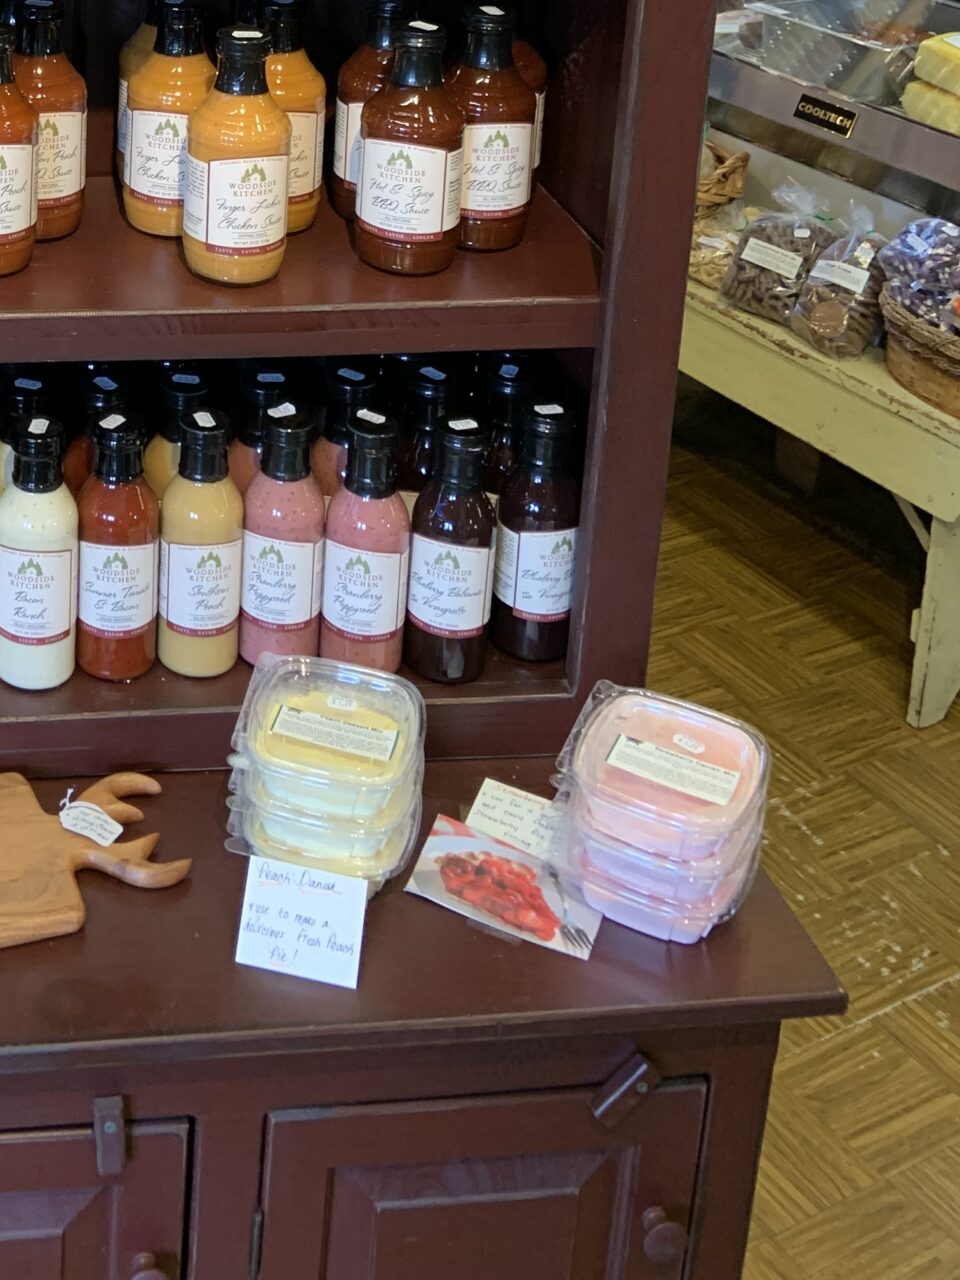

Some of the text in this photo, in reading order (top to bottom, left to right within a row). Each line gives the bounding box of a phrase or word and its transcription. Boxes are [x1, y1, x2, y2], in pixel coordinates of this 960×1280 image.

[798, 102, 851, 128] COOLTECH
[377, 164, 426, 176] WOODSIDE
[229, 180, 277, 190] WOODSIDE
[380, 174, 421, 183] KITCHEN
[500, 179, 522, 192] Sauce
[1, 180, 27, 197] Peach
[390, 184, 404, 195] &
[408, 186, 434, 204] Spicy
[371, 196, 429, 215] BBQ Sauce
[218, 215, 282, 230] Chicken Sauce
[14, 608, 46, 620] Ranch
[257, 861, 290, 884] Peach
[278, 907, 289, 918] to
[327, 933, 354, 956] Peach
